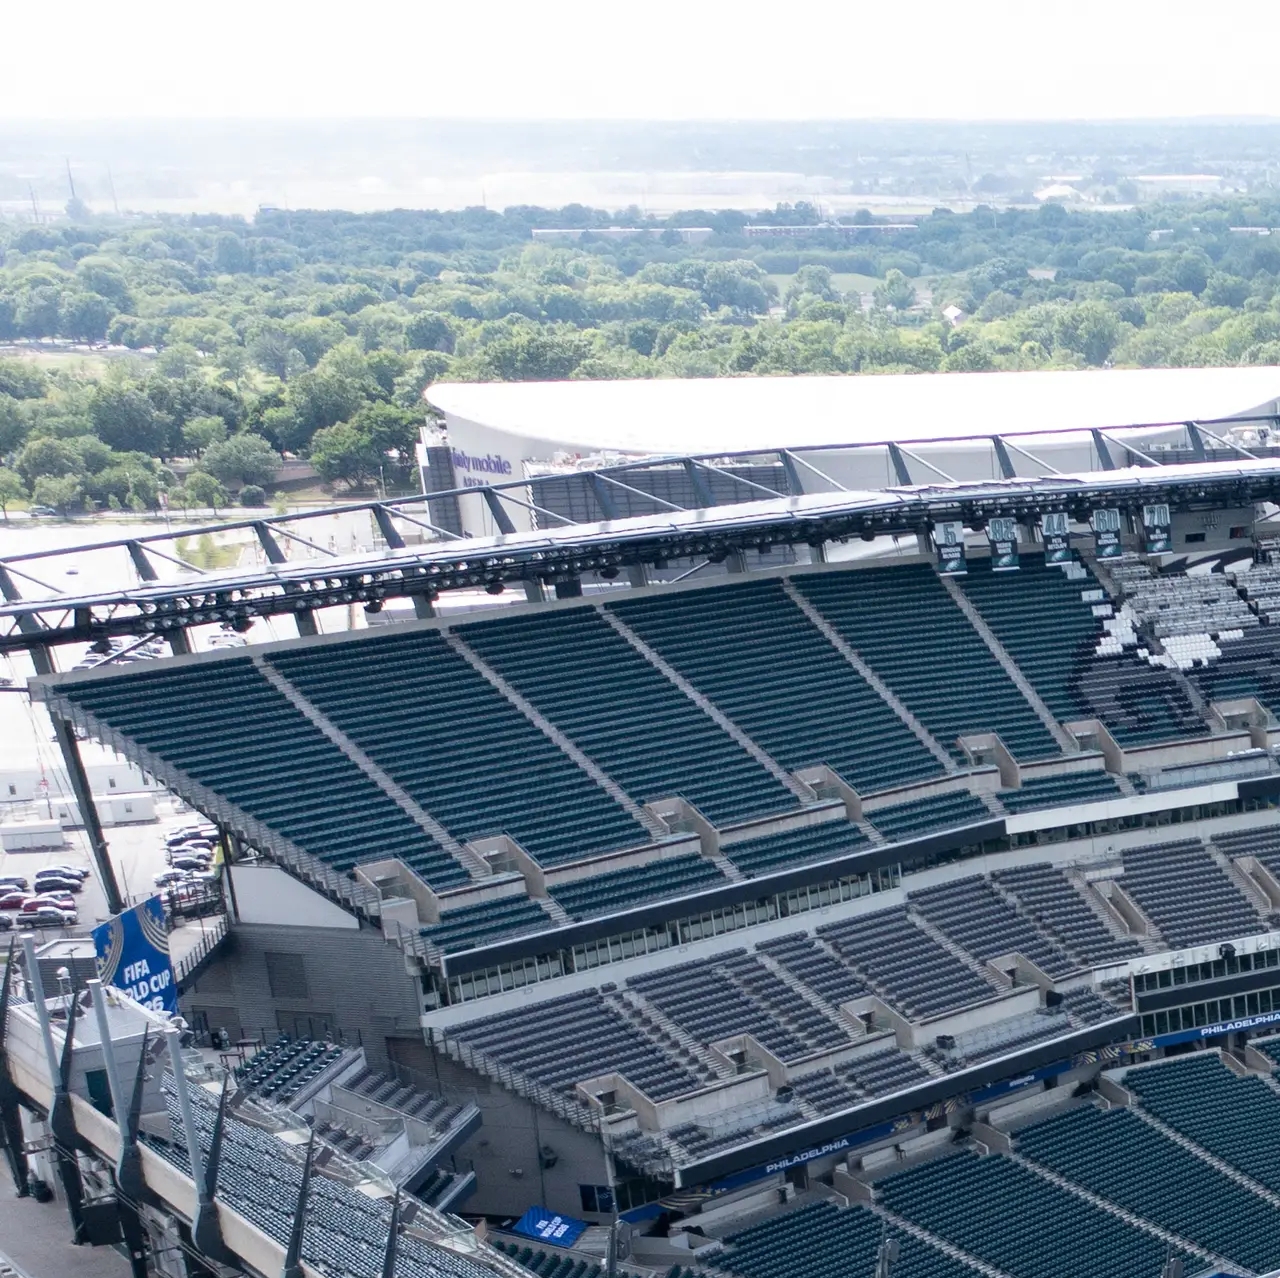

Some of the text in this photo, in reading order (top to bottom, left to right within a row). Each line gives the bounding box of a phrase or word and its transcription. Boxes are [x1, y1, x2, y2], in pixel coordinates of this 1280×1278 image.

[471, 453, 512, 475] mobile
[1045, 513, 1067, 537] 44
[1095, 508, 1119, 532] 60
[1147, 504, 1171, 527] 70
[943, 523, 956, 546] 5
[123, 959, 151, 985] FIFA
[149, 969, 171, 993] CUP
[766, 1138, 850, 1173] PHILADELPHIA
